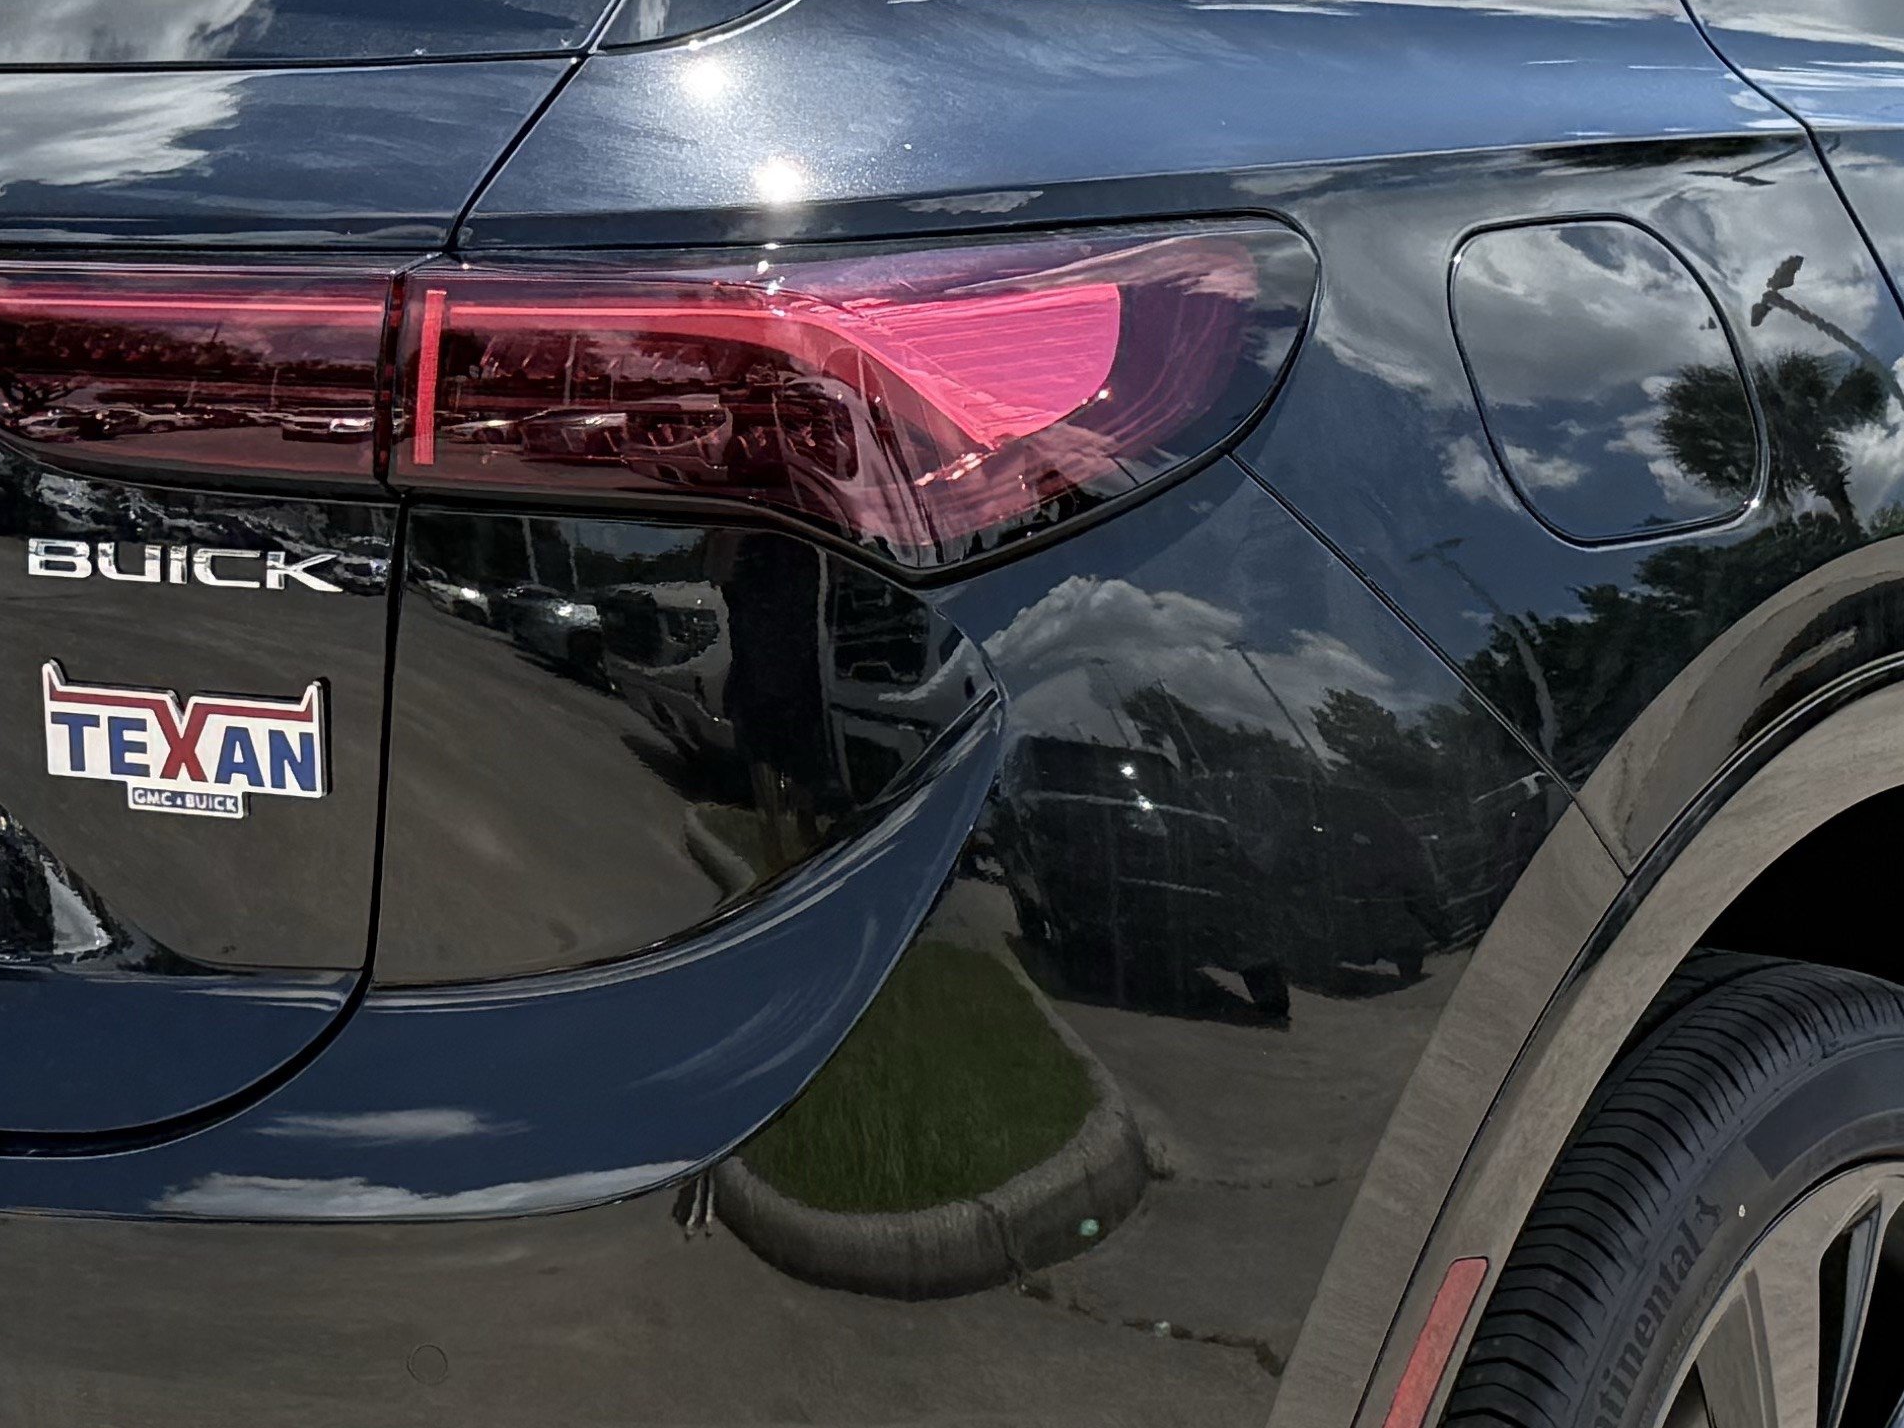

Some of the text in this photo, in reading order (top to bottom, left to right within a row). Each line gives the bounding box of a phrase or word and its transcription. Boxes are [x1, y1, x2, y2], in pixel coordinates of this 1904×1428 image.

[28, 538, 344, 593] BUICK
[49, 675, 318, 792] TEXAN
[134, 789, 237, 812] GMC BUICK
